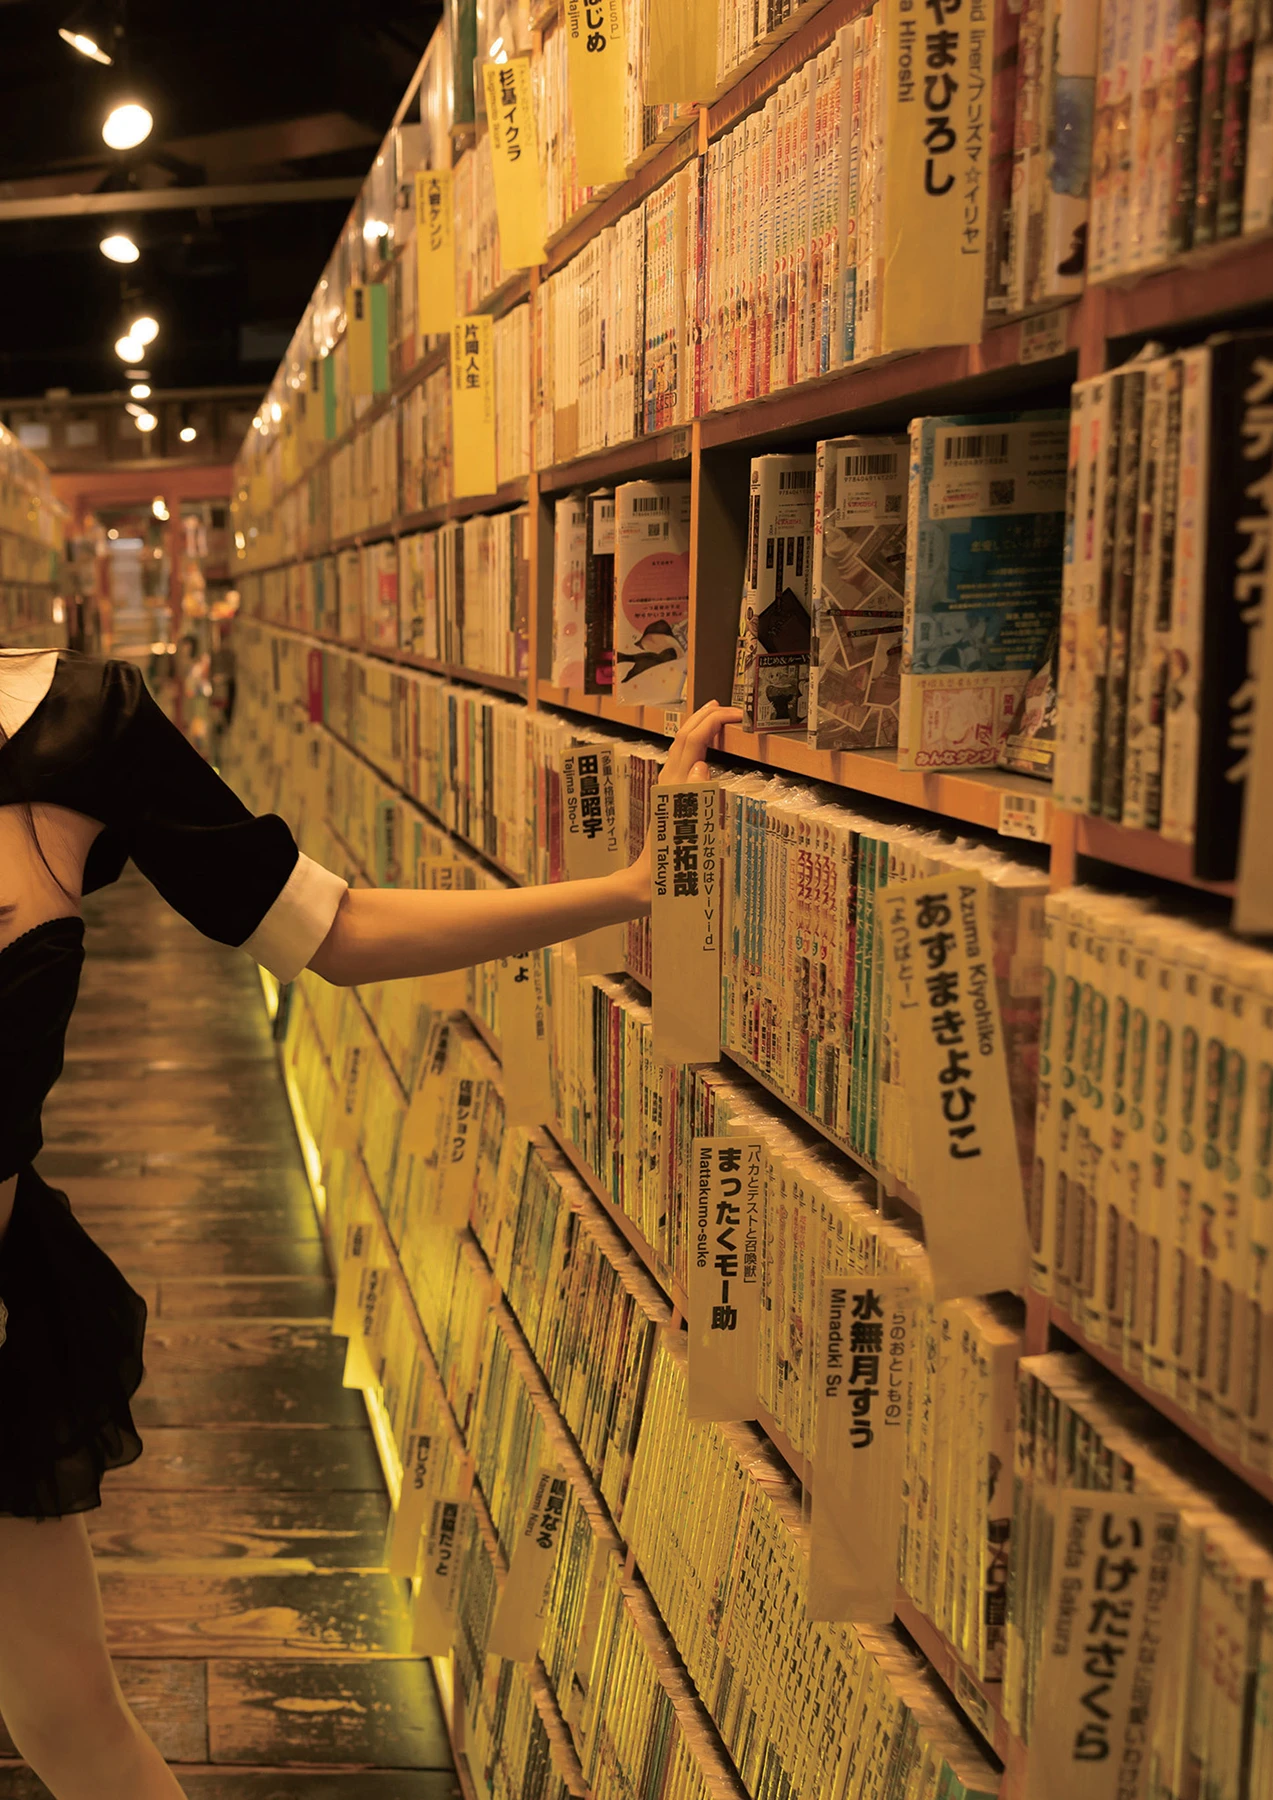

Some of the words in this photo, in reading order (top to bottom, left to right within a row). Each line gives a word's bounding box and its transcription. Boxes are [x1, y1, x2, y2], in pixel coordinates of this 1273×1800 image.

[898, 20, 916, 103] Hiroshi
[563, 756, 576, 795] Tajima
[567, 797, 580, 833] Sho-U
[578, 754, 603, 839] 田島昭宇
[654, 794, 669, 842] Fujima
[654, 845, 669, 896] Takuya
[673, 792, 699, 897] 藤真拓哉
[958, 885, 981, 958] Azuma
[915, 892, 981, 1159] あずまきよひこ
[967, 963, 994, 1056] Kiyohiko
[696, 1147, 713, 1268] Mattakumo-suke
[711, 1147, 742, 1331] まったくモー助
[743, 1144, 761, 1284] 「バカとテストと召喚獣」
[827, 1288, 847, 1369] Minaduki
[848, 1288, 884, 1449] 水無月すう
[885, 1286, 910, 1426] 「らのおとしもの」
[826, 1374, 842, 1397] Su
[1072, 1512, 1143, 1761] いけださくら
